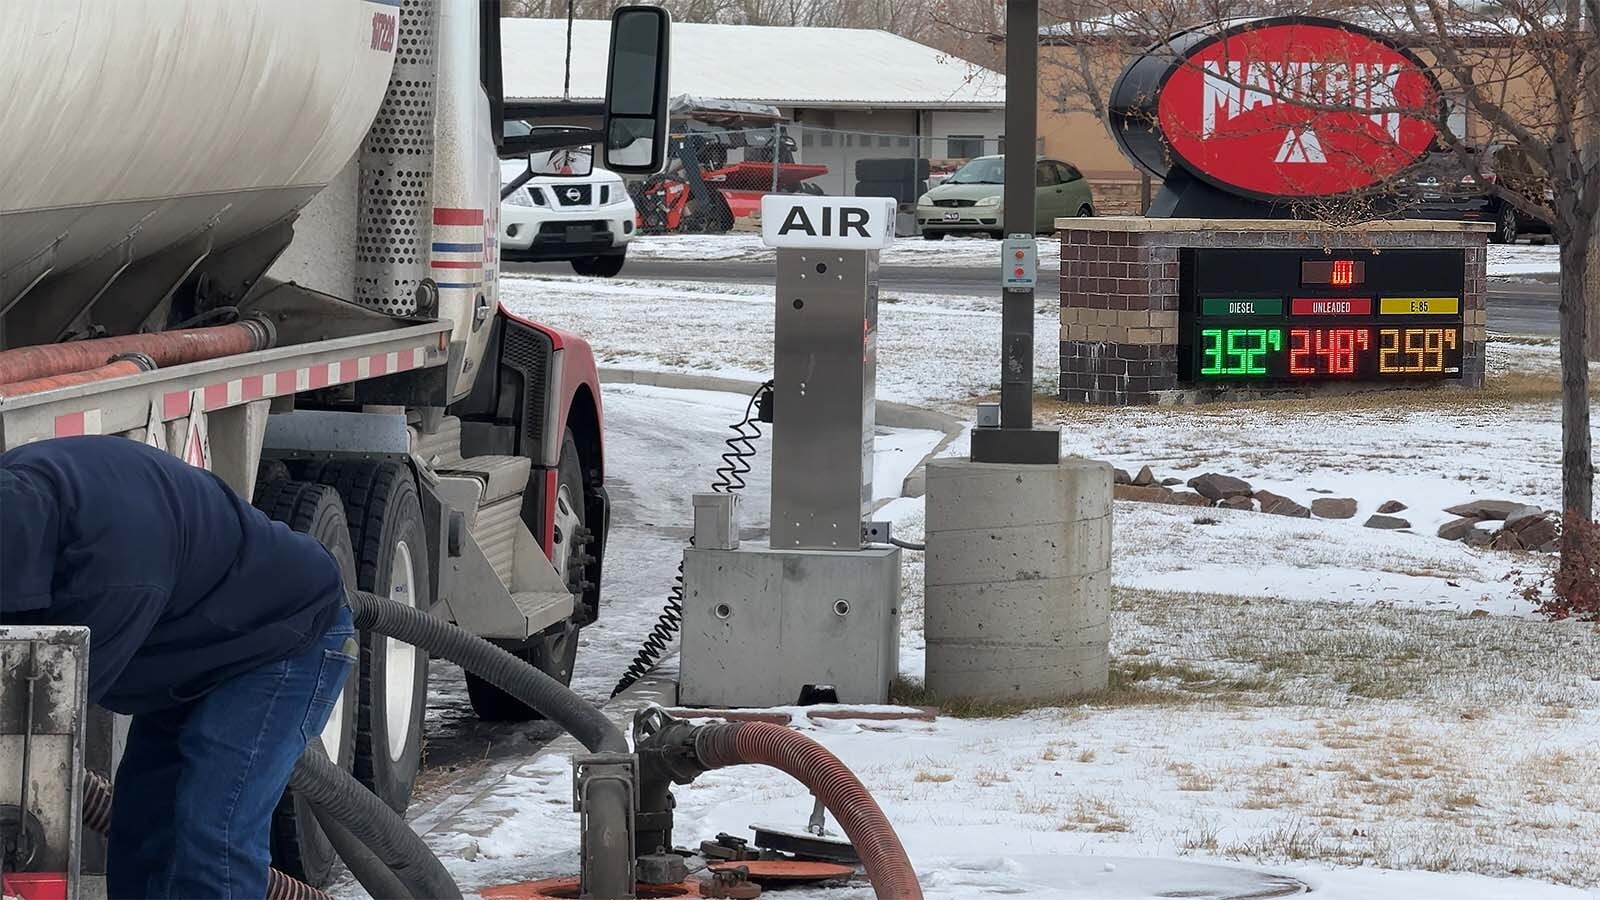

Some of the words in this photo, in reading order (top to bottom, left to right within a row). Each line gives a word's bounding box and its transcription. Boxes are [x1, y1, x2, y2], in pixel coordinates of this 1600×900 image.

[777, 206, 872, 238] AIR
[1229, 302, 1255, 314] DIESEL
[1313, 302, 1351, 313] UNLEADED
[1410, 301, 1429, 312] E-85
